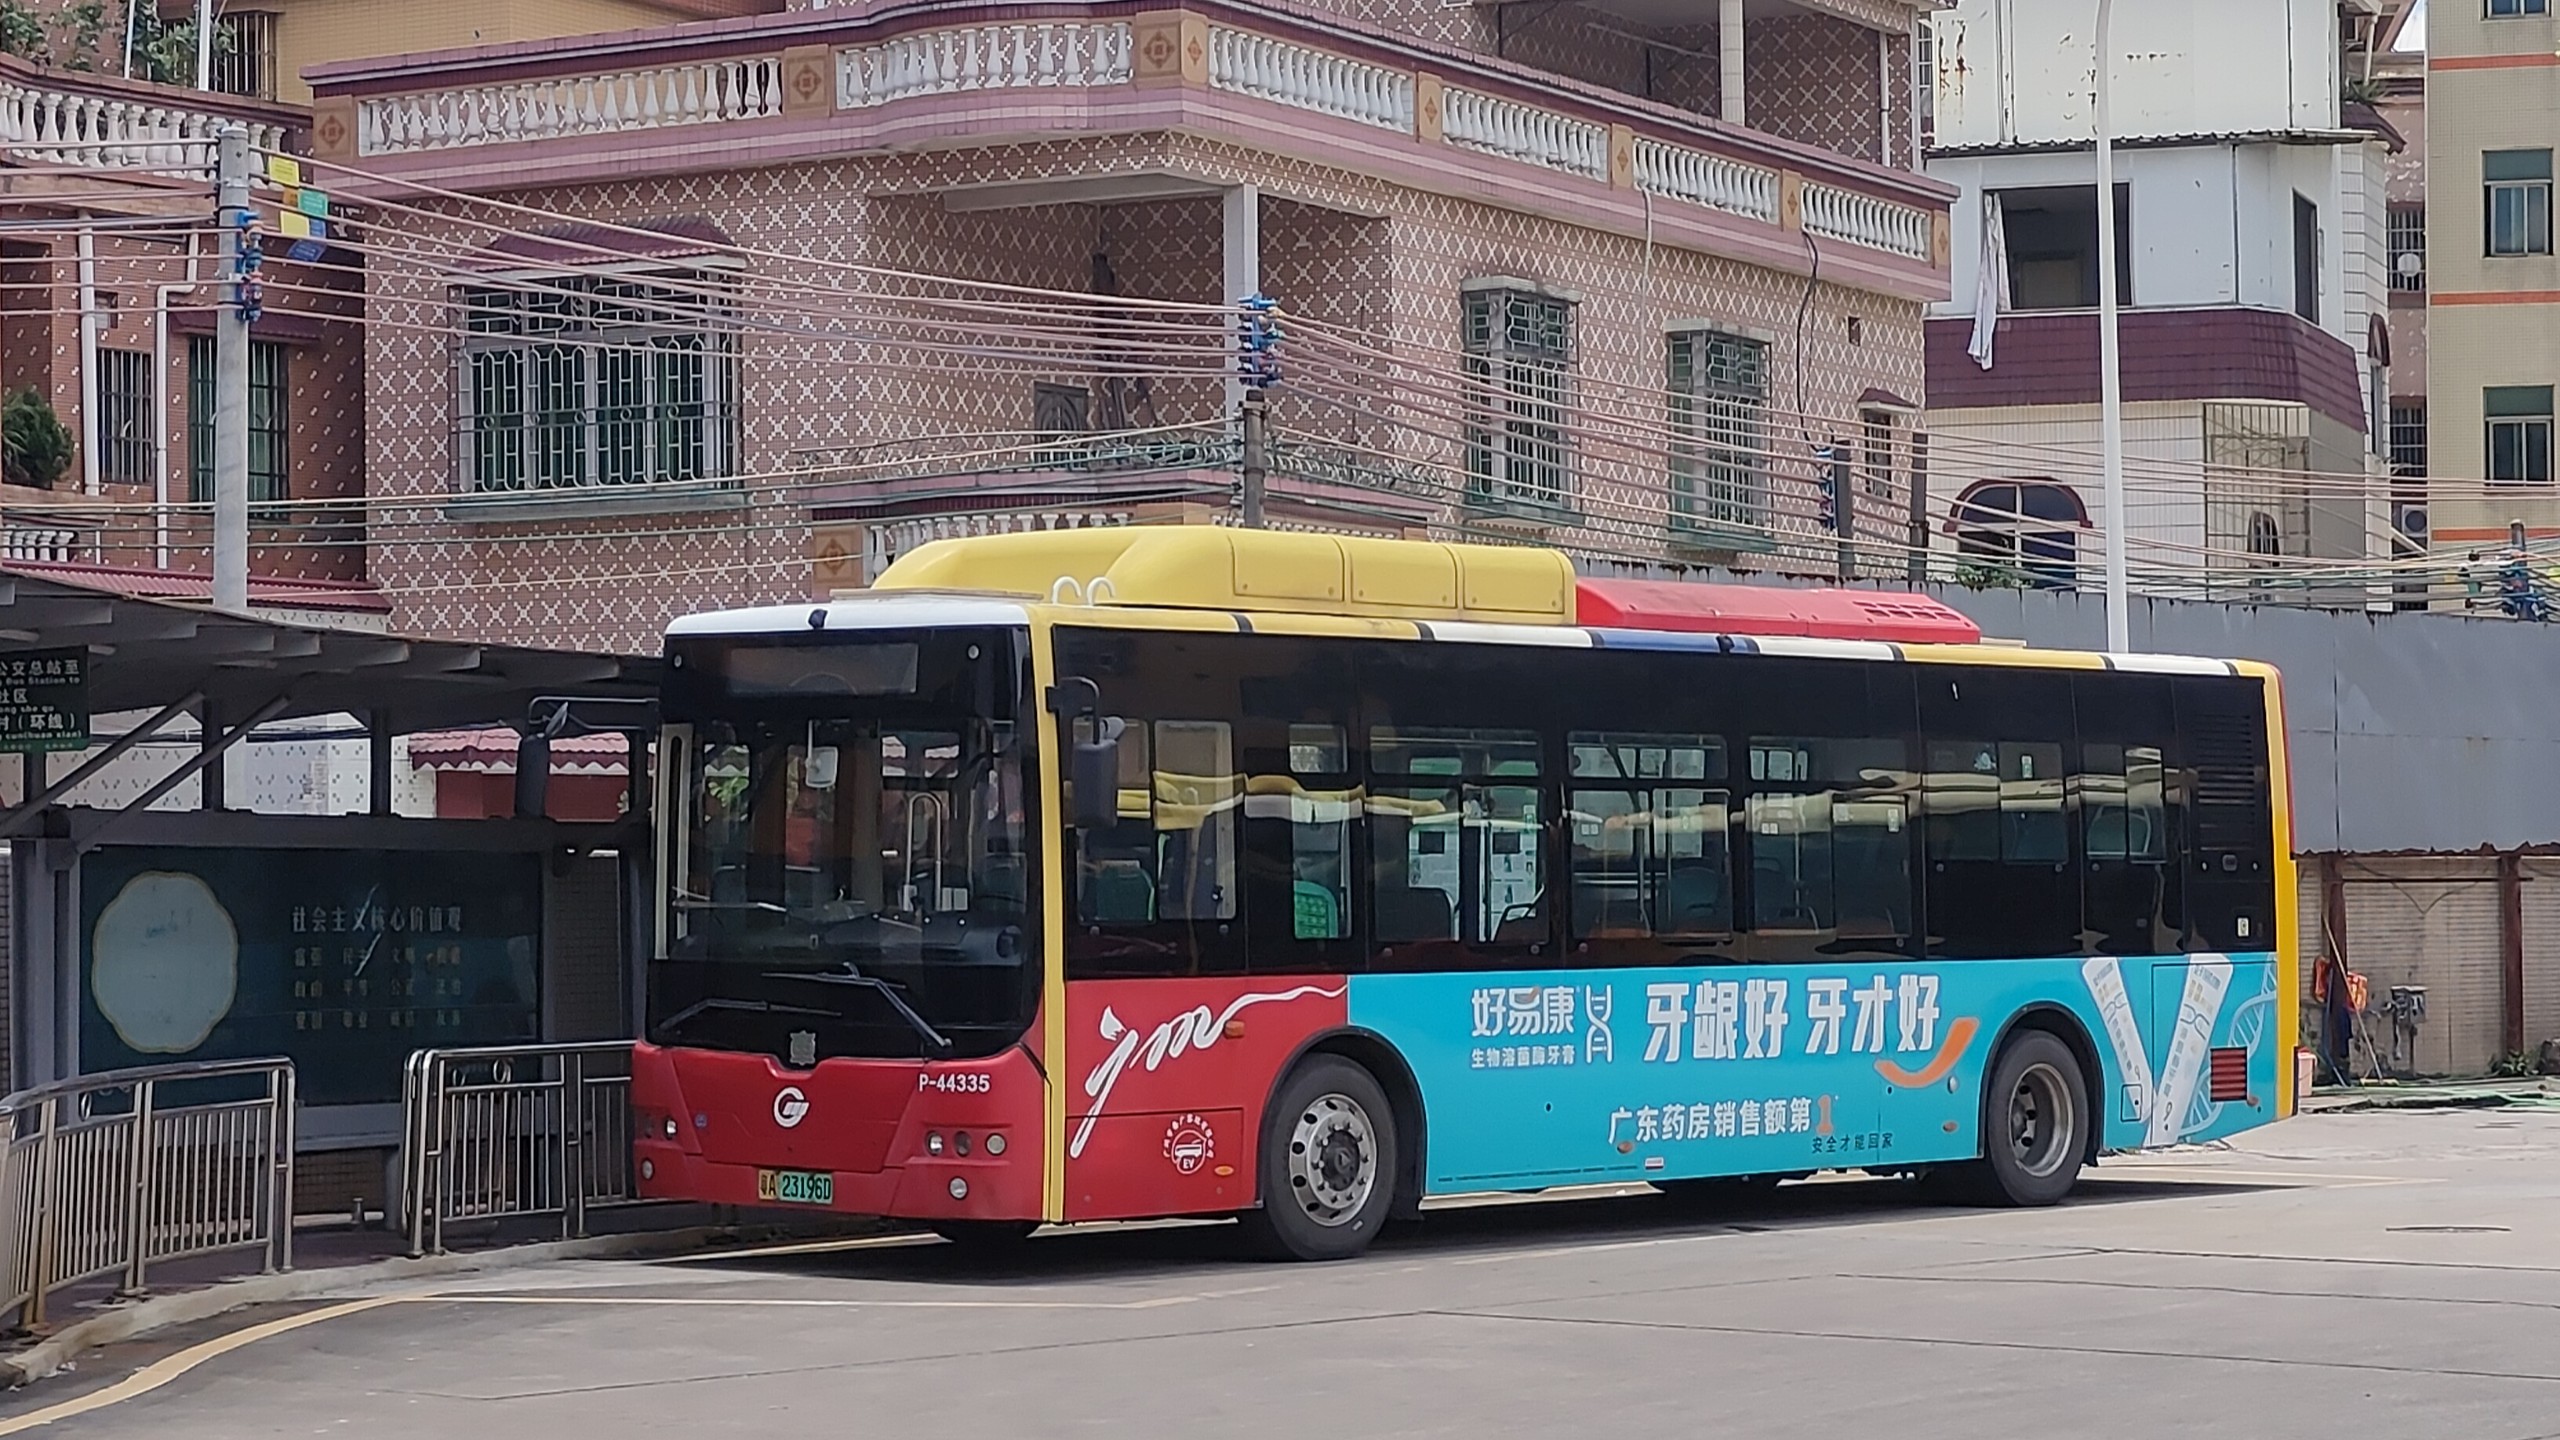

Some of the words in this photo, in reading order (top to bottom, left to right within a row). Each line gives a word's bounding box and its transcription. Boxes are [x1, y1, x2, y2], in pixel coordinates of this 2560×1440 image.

[28, 676, 66, 684] Station
[69, 675, 80, 684] to
[291, 905, 462, 932] 社会主义核心价值观
[1471, 985, 1575, 1037] 好易康
[1643, 978, 1789, 1063] 牙龈好
[1804, 974, 1941, 1055] 牙才好
[918, 1072, 991, 1093] P-44335
[1811, 1132, 1894, 1154] 安全才能回家
